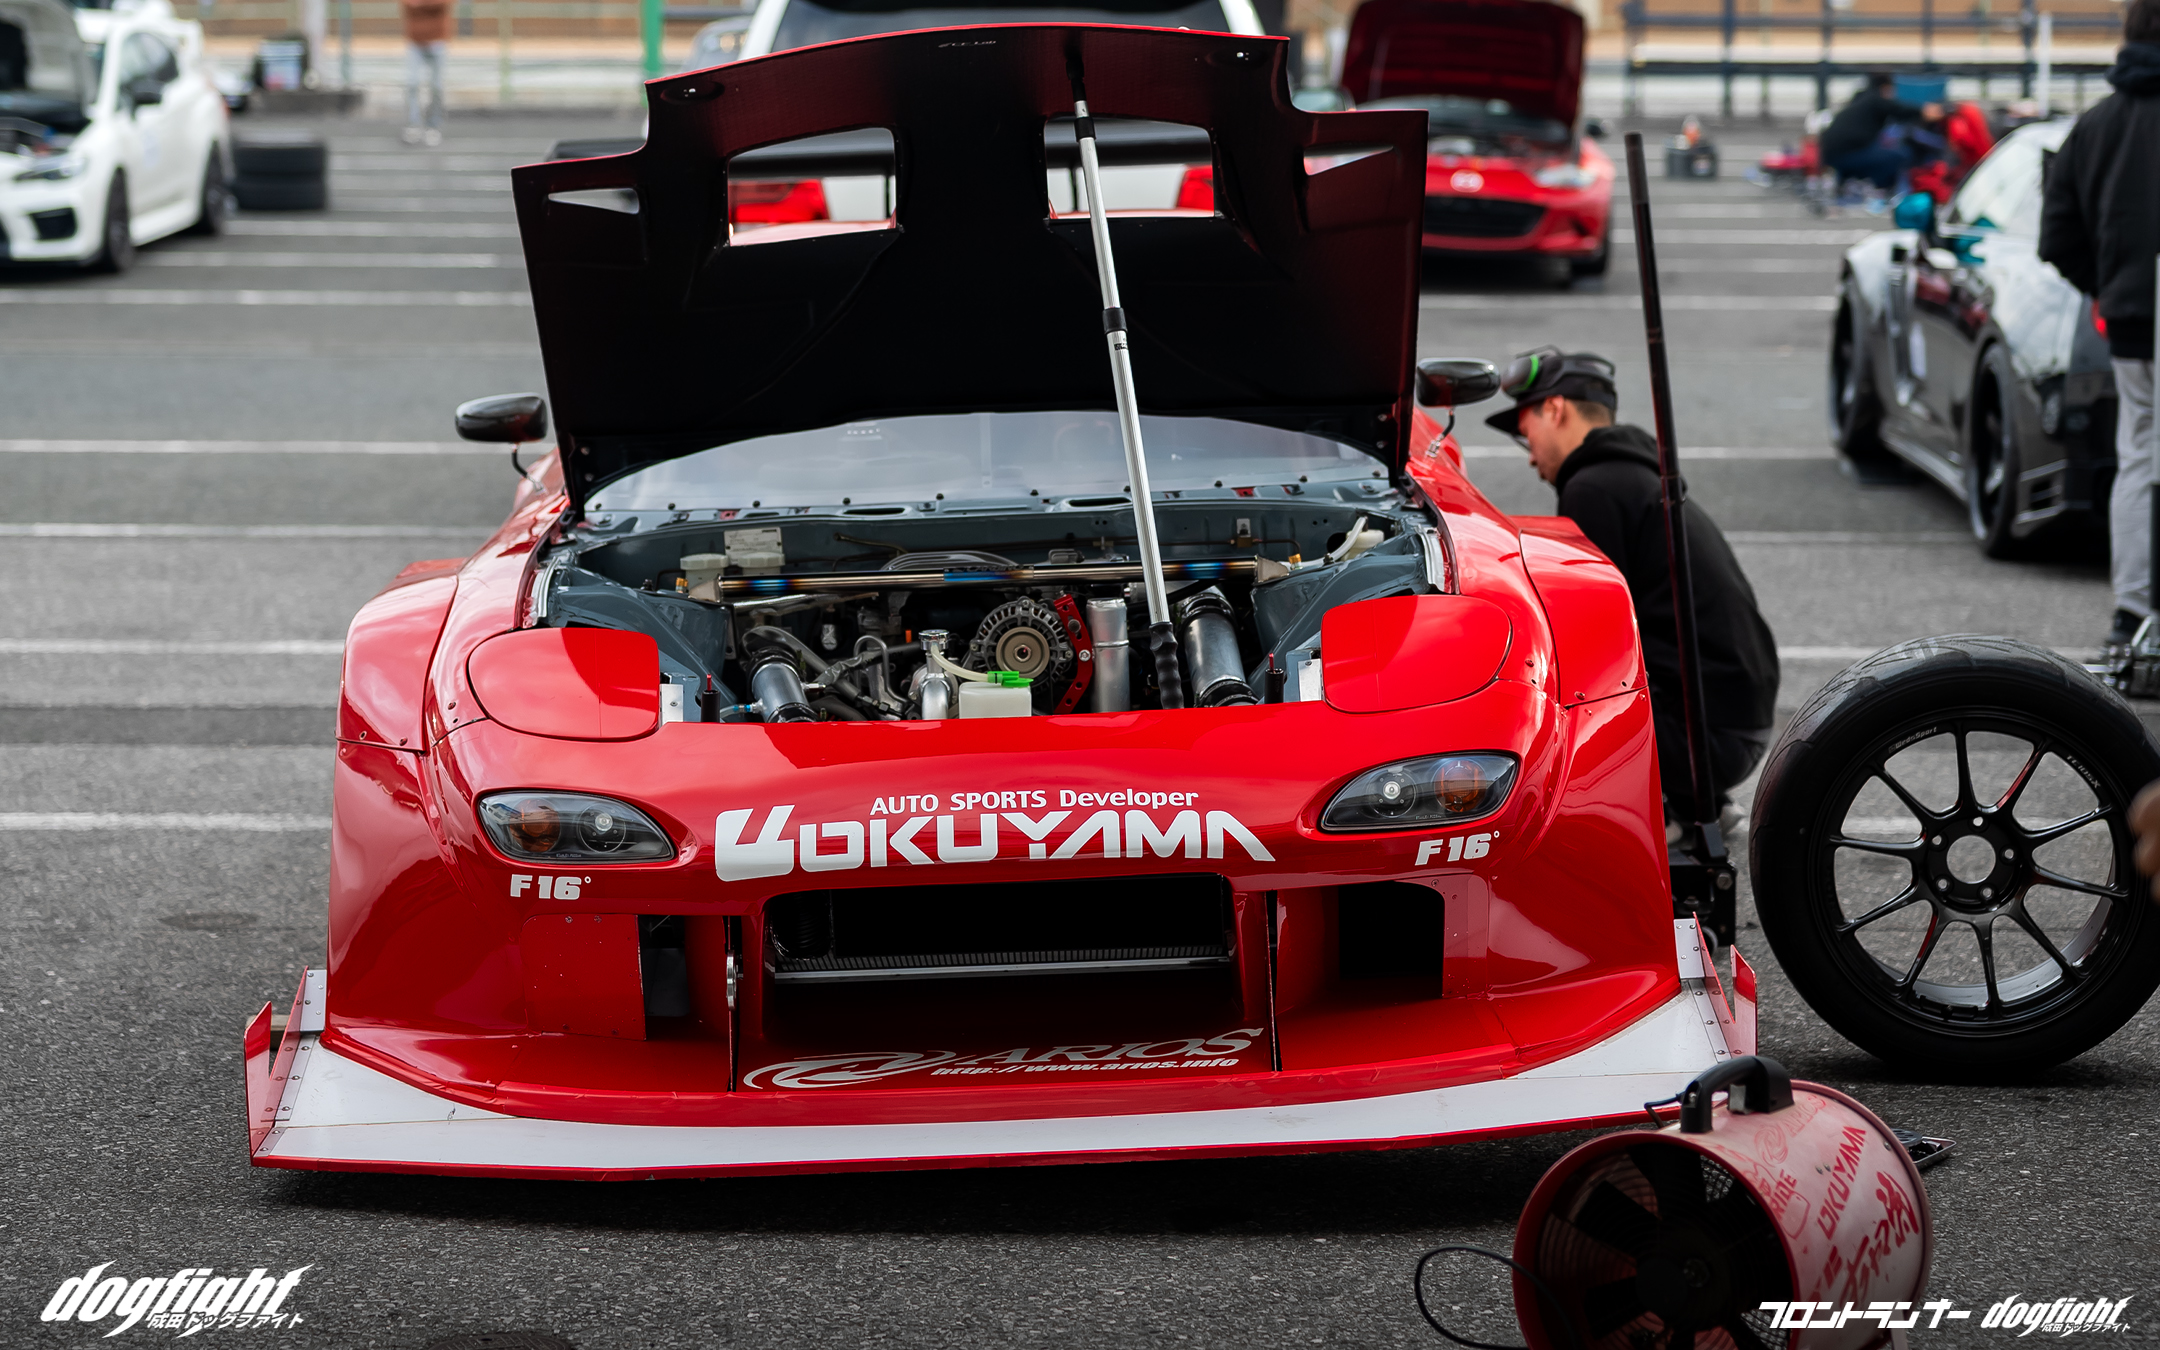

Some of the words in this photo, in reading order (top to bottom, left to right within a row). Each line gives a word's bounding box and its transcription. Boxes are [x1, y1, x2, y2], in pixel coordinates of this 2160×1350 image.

[870, 793, 938, 816] AUTO
[950, 789, 1047, 812] SPORTS
[1059, 788, 1199, 809] Developer
[955, 1028, 1264, 1065] ARIOS
[930, 1058, 1239, 1076] http://www.arios.info
[1817, 1126, 1867, 1241] OKUYAMA
